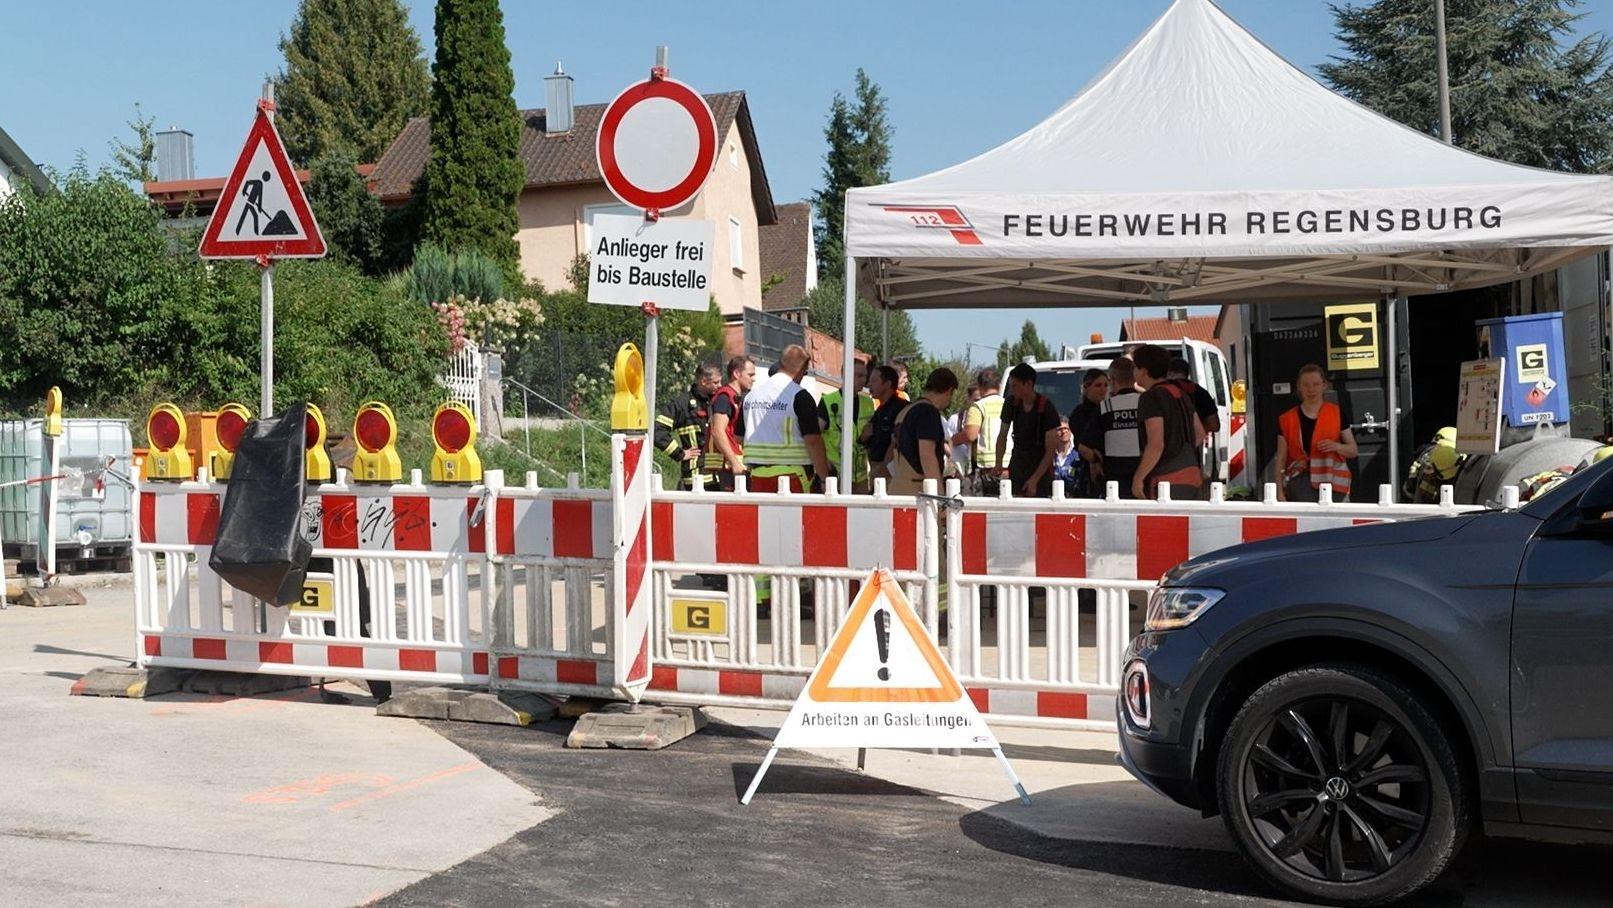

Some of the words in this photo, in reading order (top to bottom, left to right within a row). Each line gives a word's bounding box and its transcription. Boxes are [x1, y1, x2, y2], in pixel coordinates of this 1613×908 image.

[910, 215, 941, 225] 112
[1003, 212, 1228, 237] FEUERWEHR
[1246, 205, 1502, 234] REGENSBURG
[597, 236, 668, 263] Anlieger
[675, 240, 704, 261] frei
[597, 264, 622, 284] bis
[628, 266, 707, 290] Baustelle
[1337, 315, 1374, 346] G
[1524, 351, 1544, 368] G
[302, 588, 318, 605] G
[690, 608, 709, 626] G
[801, 712, 858, 727] Arbeiten
[863, 715, 879, 726] an
